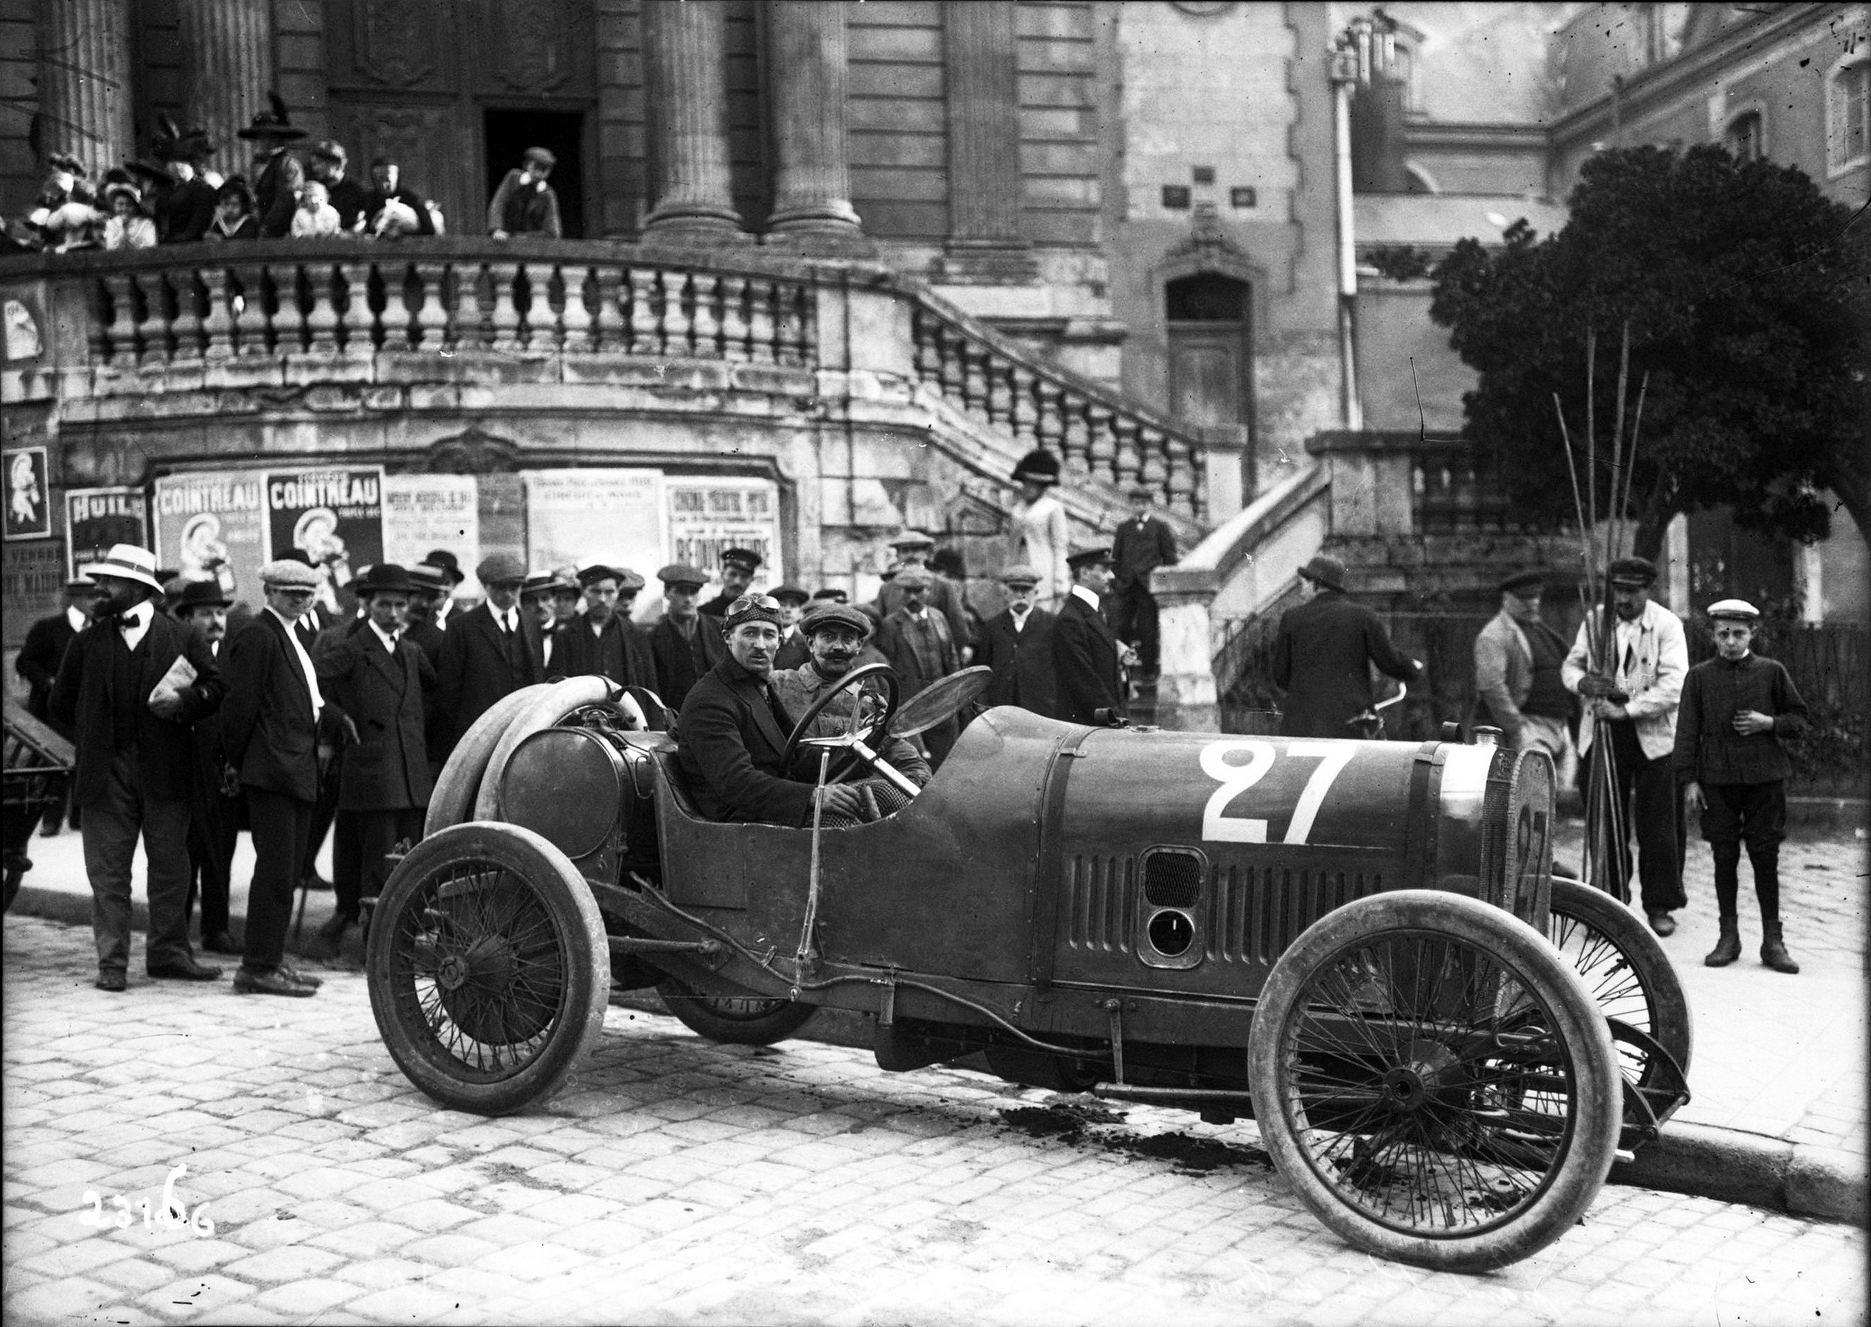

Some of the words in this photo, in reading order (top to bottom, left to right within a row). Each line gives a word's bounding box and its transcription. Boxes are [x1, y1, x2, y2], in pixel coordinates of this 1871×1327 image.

[160, 482, 259, 515] COINTREAU
[270, 477, 378, 510] COINTREAU
[1200, 740, 1358, 845] 27
